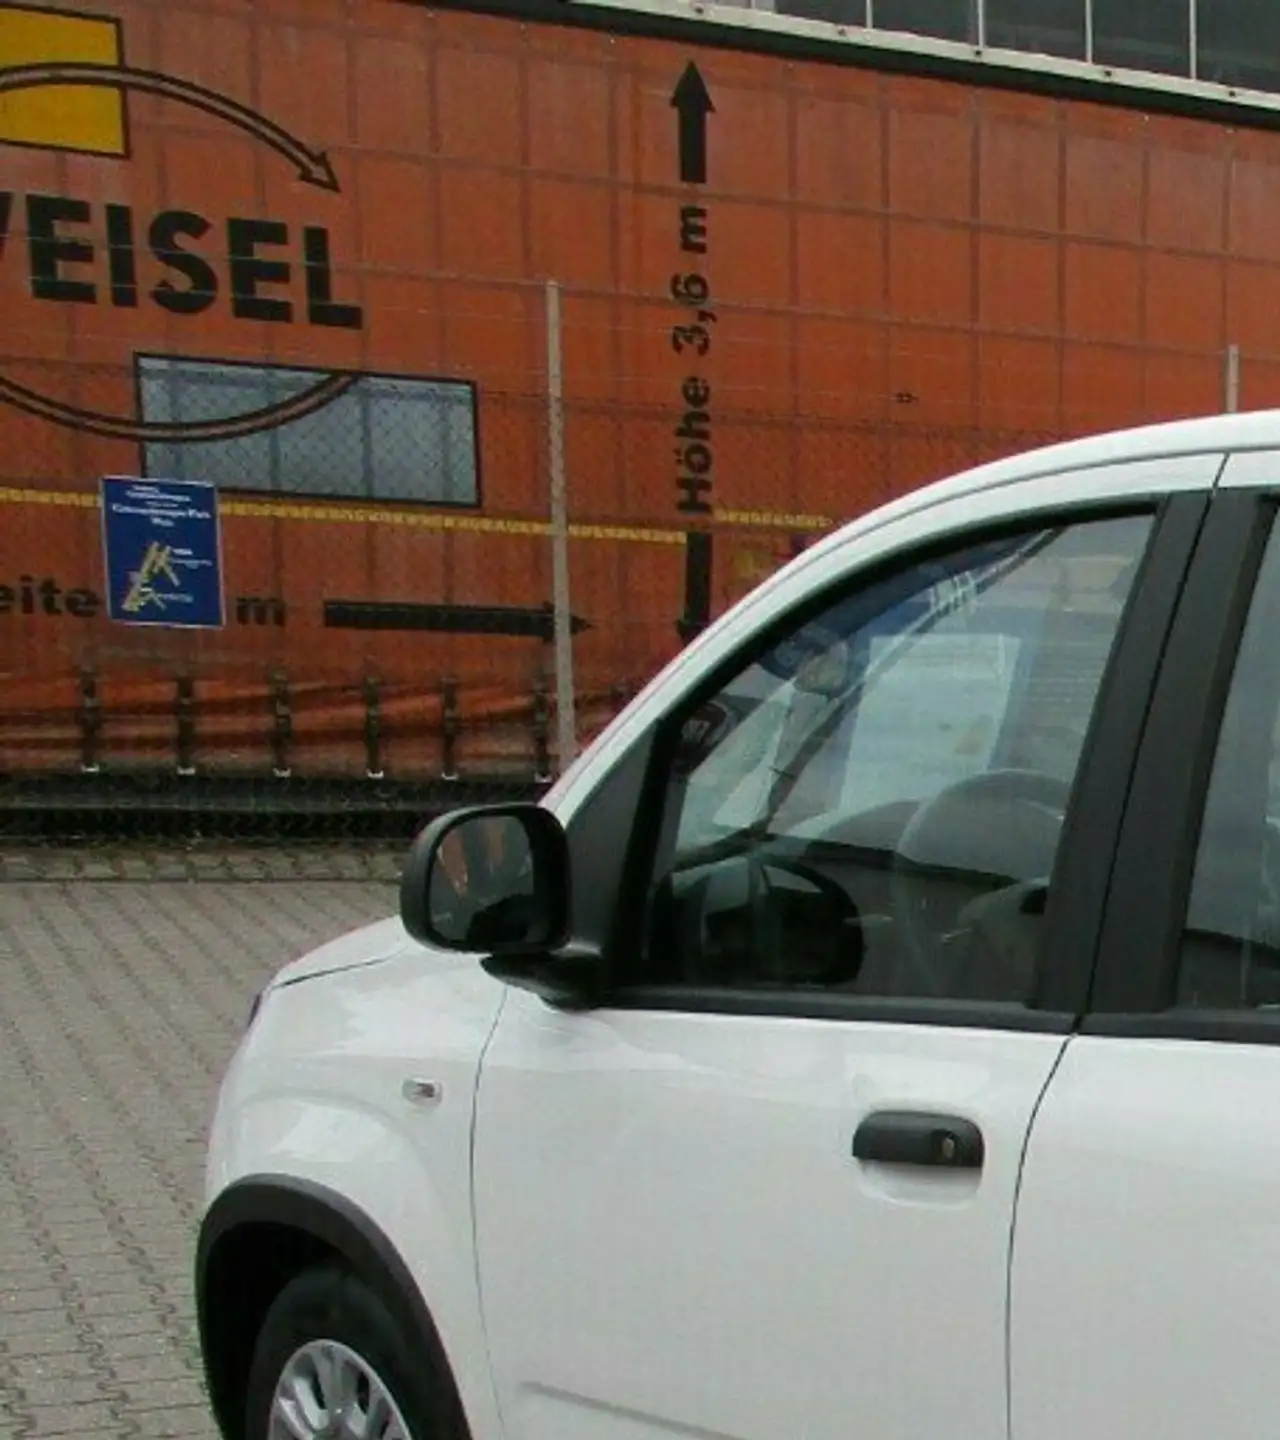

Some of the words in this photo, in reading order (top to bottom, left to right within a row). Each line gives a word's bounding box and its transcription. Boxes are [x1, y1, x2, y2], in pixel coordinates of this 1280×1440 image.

[680, 206, 708, 254] m
[670, 272, 717, 356] 3,6
[674, 376, 714, 514] Höhe
[236, 595, 286, 627] m
